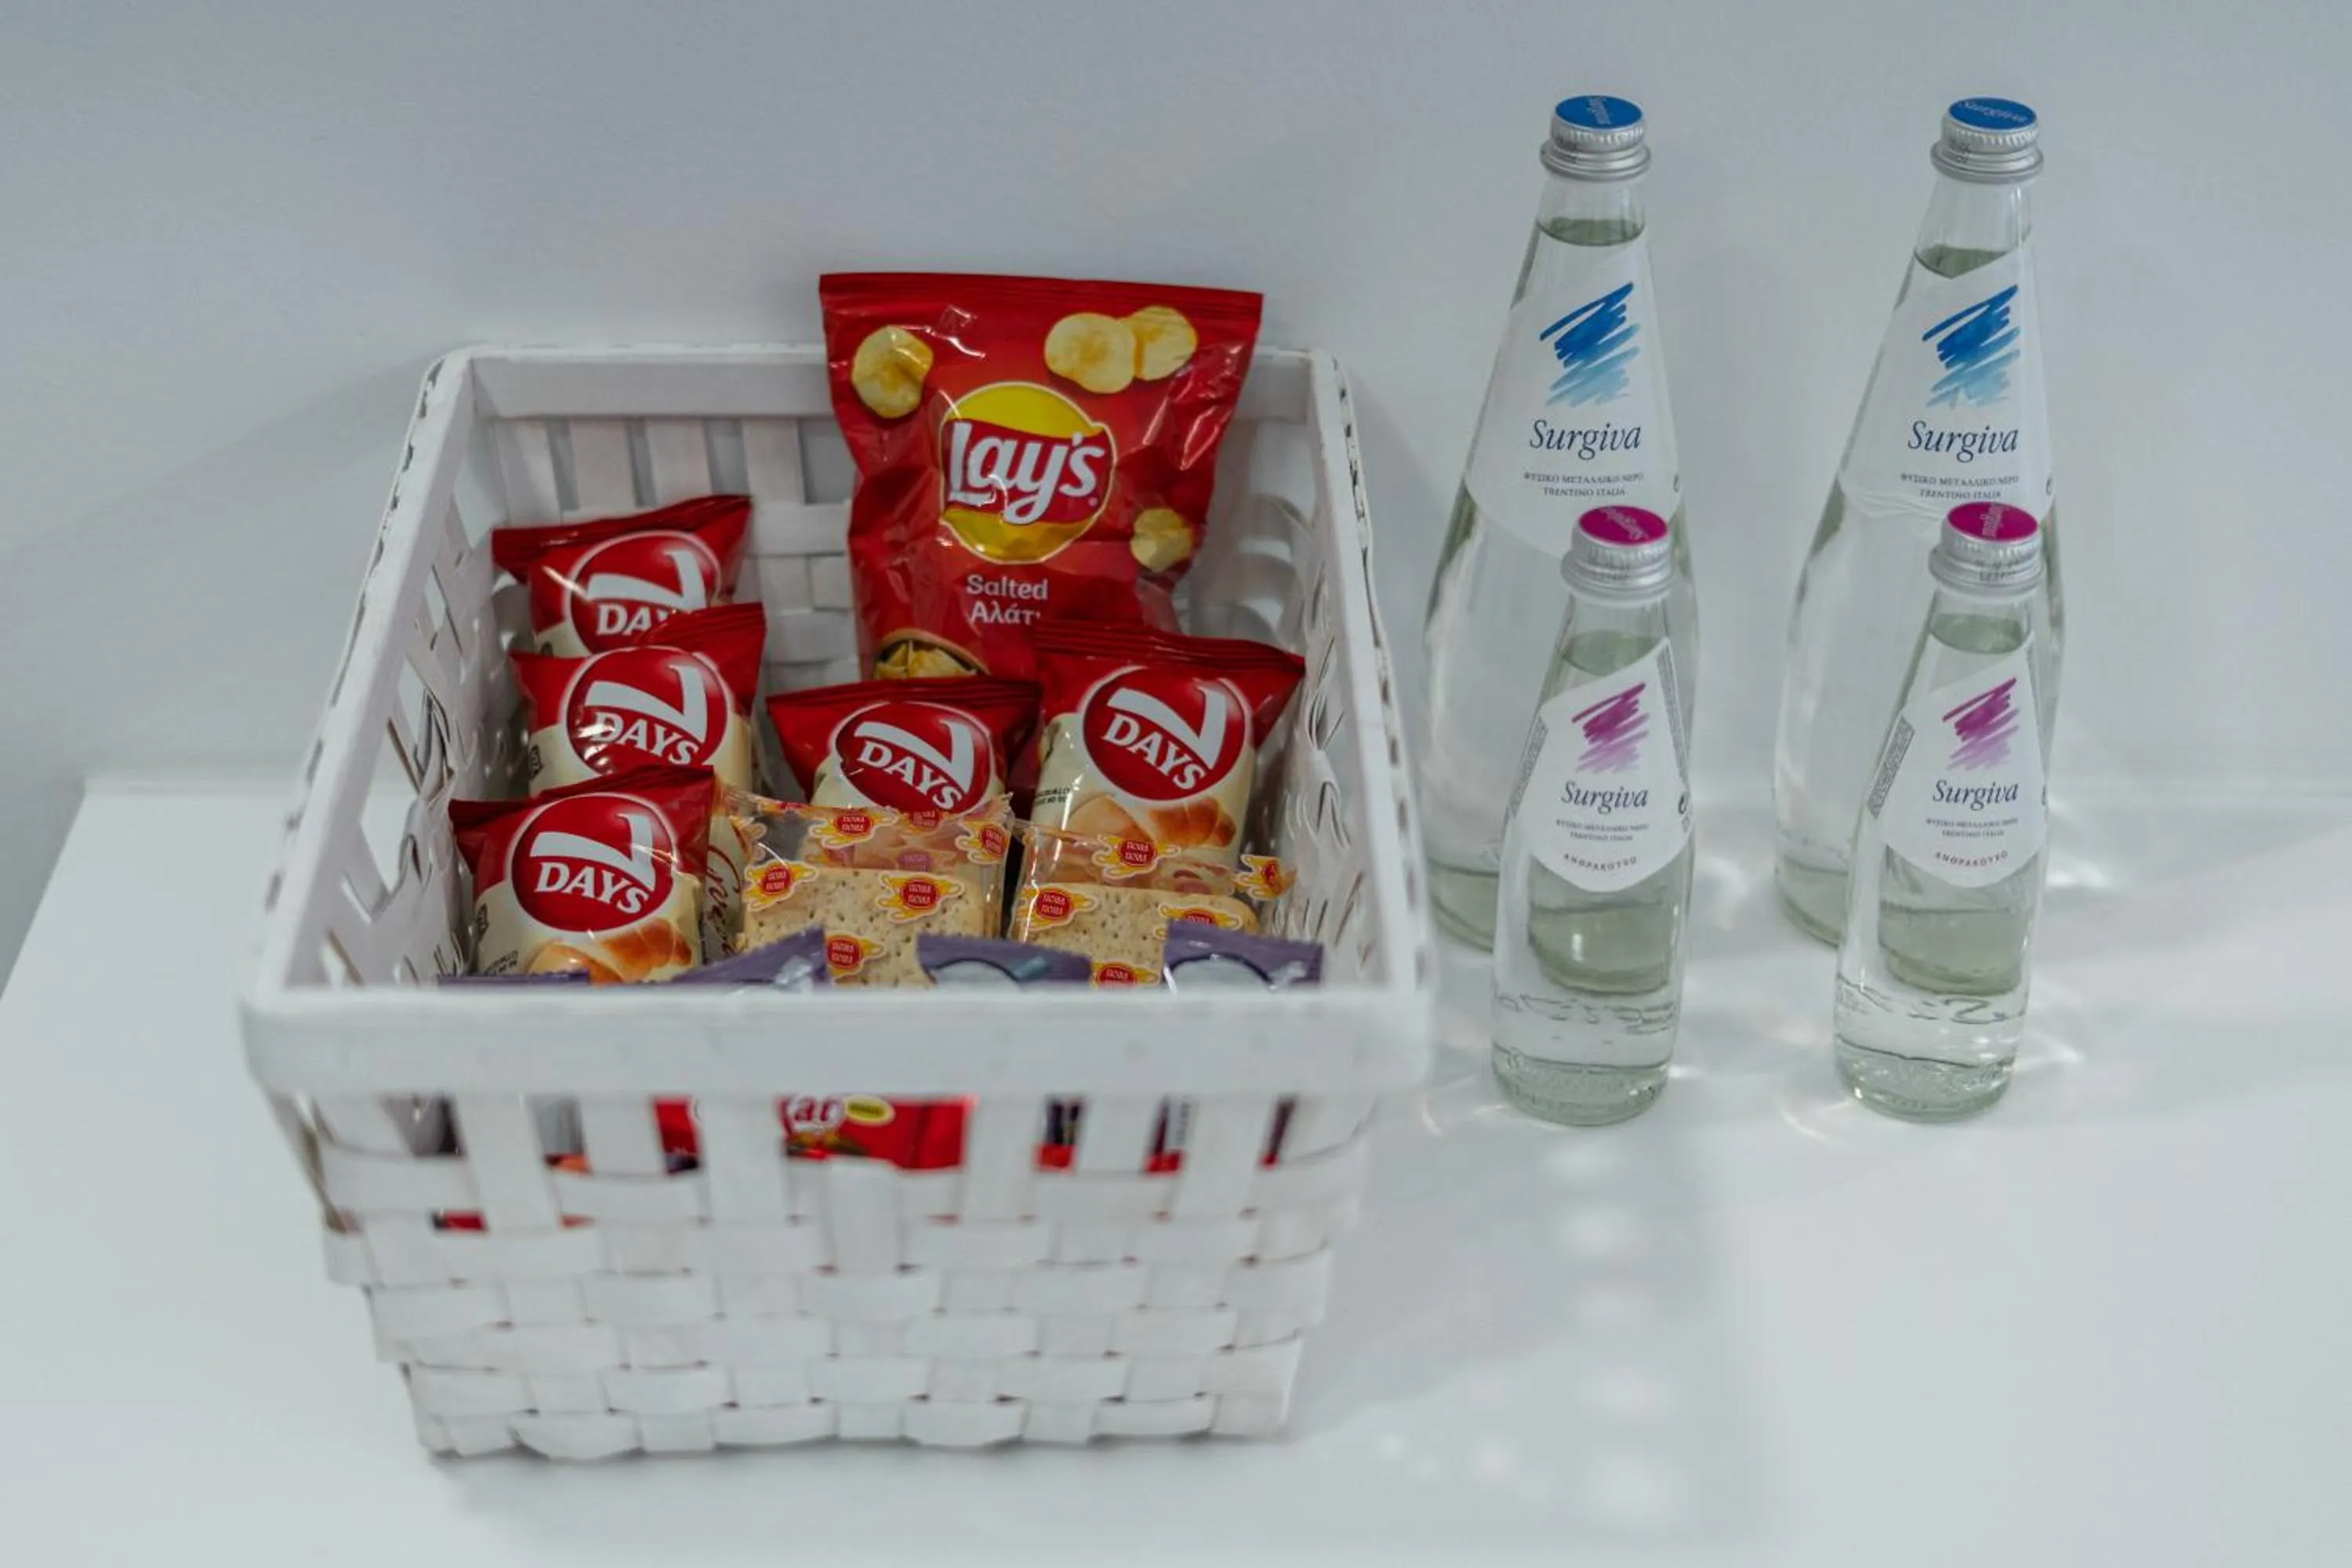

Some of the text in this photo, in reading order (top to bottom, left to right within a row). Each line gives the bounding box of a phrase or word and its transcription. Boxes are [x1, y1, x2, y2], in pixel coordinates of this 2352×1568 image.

[1529, 419, 1642, 460] Surgiva
[1907, 420, 2020, 463] Surgiva
[947, 419, 1105, 524] Lay's
[587, 550, 706, 612] 7
[966, 575, 1048, 600] Salted
[596, 602, 668, 636] DA
[585, 663, 706, 743] 7
[1108, 686, 1225, 769] 7
[591, 712, 700, 765] DAYS
[854, 719, 975, 793] 7
[1102, 713, 1208, 789] DAYS
[858, 739, 965, 811] DAYS
[1561, 780, 1649, 815] Surgiva
[1933, 779, 2019, 811] Surgiva
[530, 815, 656, 892] 7
[535, 862, 650, 915] DAYS
